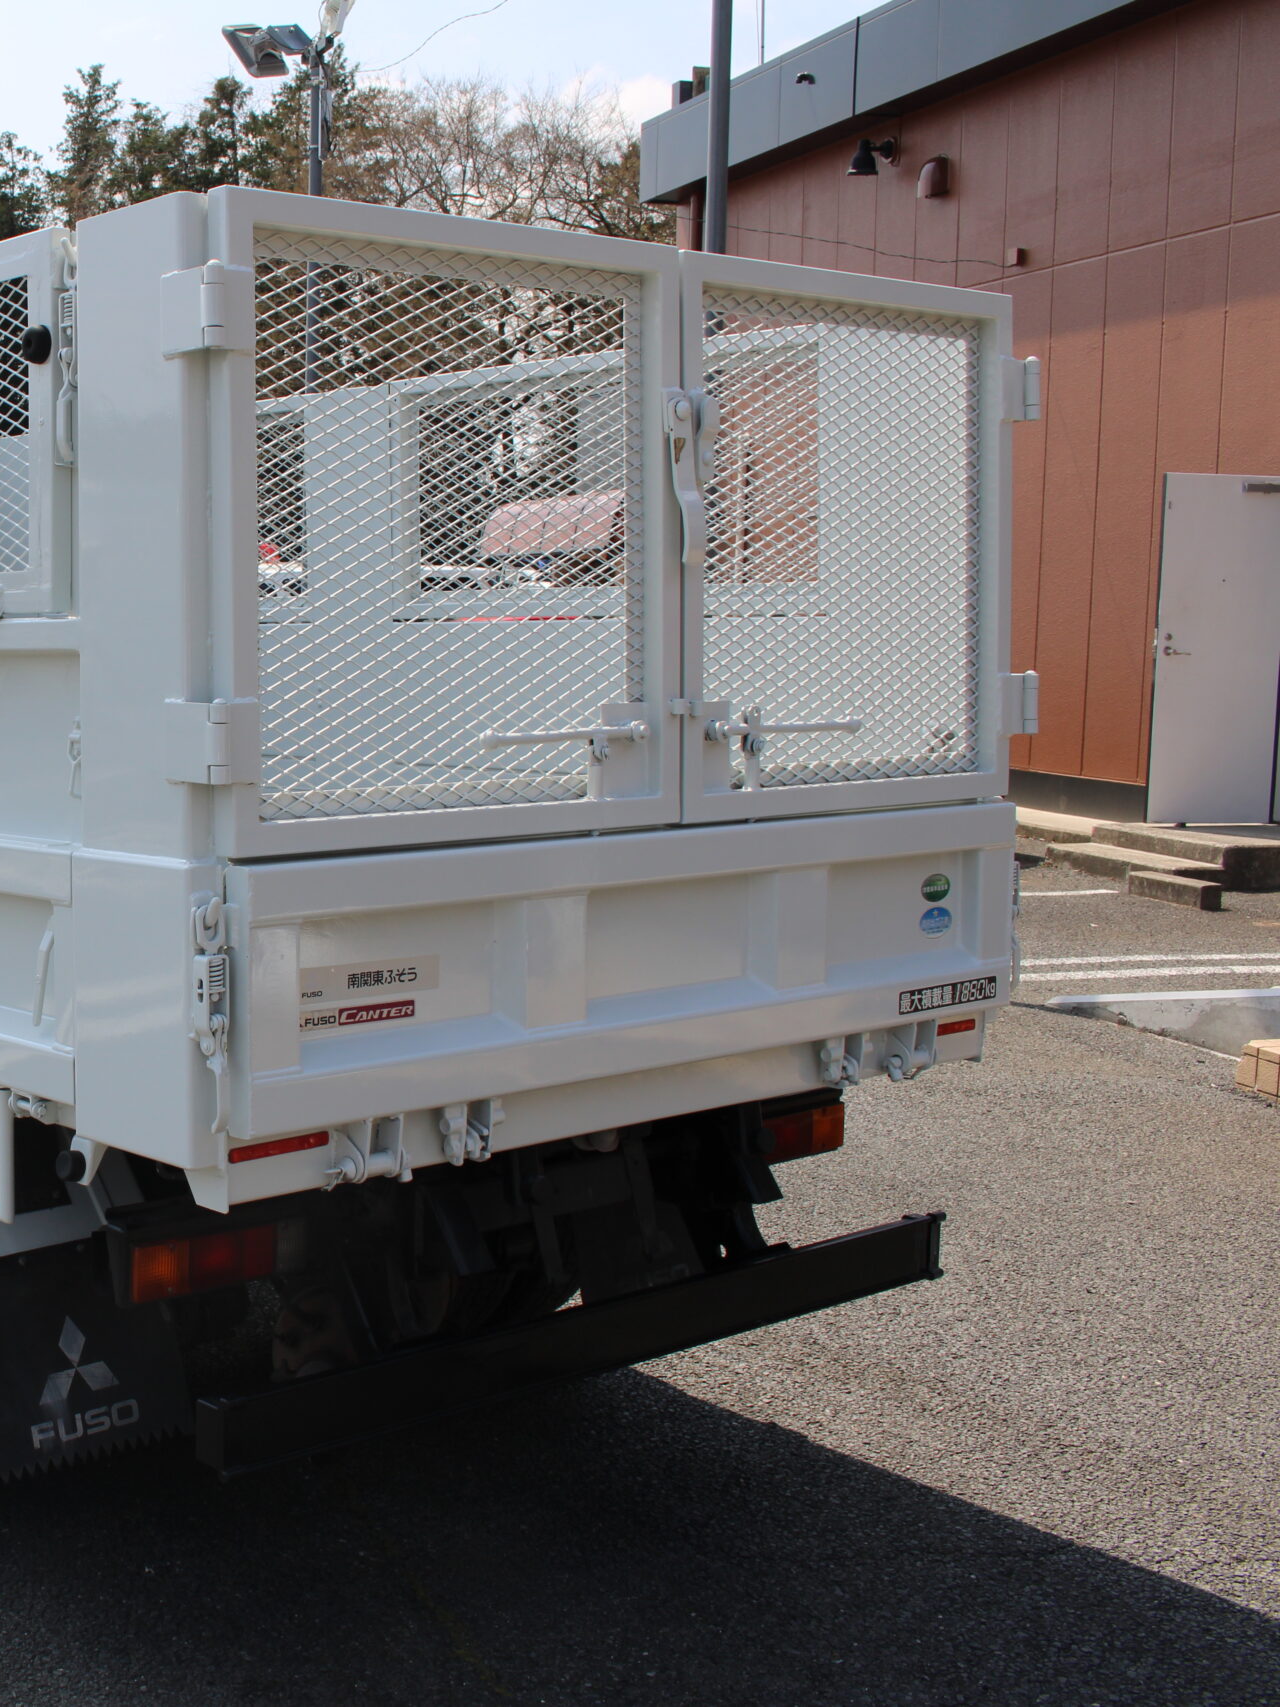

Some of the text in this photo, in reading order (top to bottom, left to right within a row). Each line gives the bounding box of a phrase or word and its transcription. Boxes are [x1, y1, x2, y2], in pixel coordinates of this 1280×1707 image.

[347, 967, 418, 989] 南関東ふそう
[301, 990, 323, 999] FUSO
[900, 985, 953, 1013] 最大積載量
[304, 1015, 337, 1027] FUSO
[30, 1398, 140, 1449] FUSO
